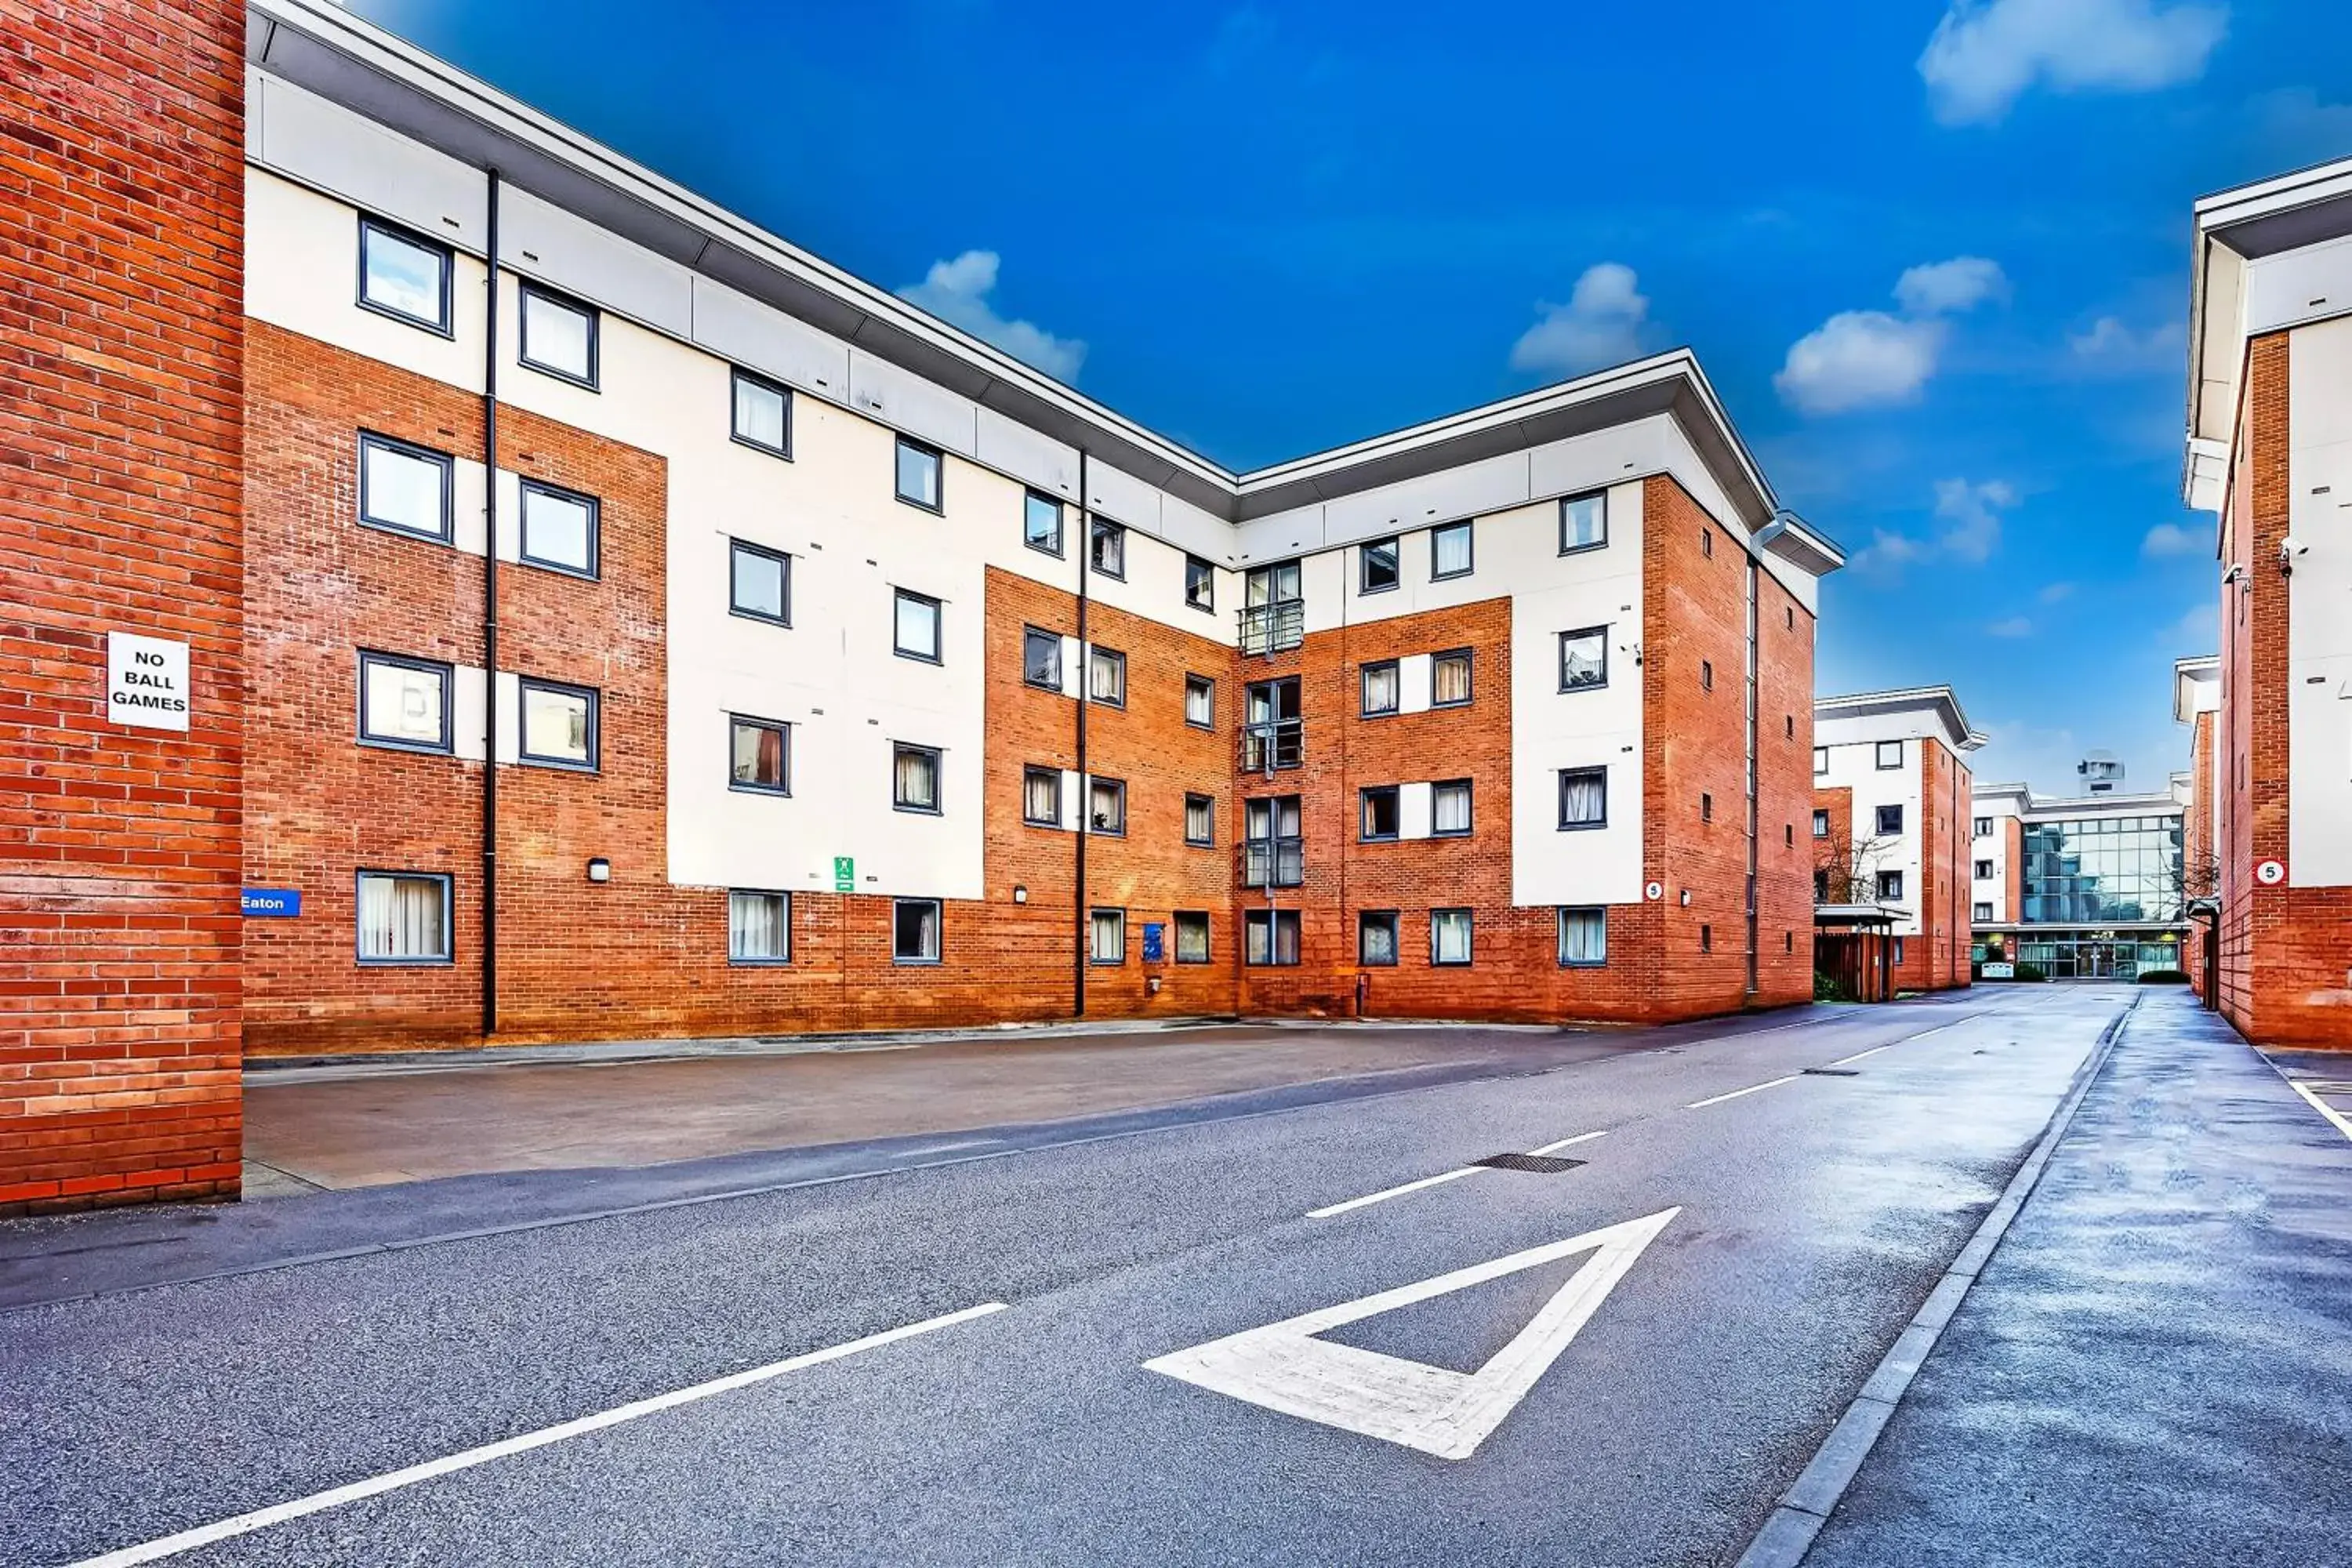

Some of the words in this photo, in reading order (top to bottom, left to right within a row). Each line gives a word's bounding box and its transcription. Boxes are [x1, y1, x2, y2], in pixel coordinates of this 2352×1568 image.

[135, 652, 165, 667] NO
[125, 671, 175, 690] BALL
[112, 691, 186, 712] GAMES
[2266, 866, 2276, 878] 5
[241, 896, 284, 909] Eaton
